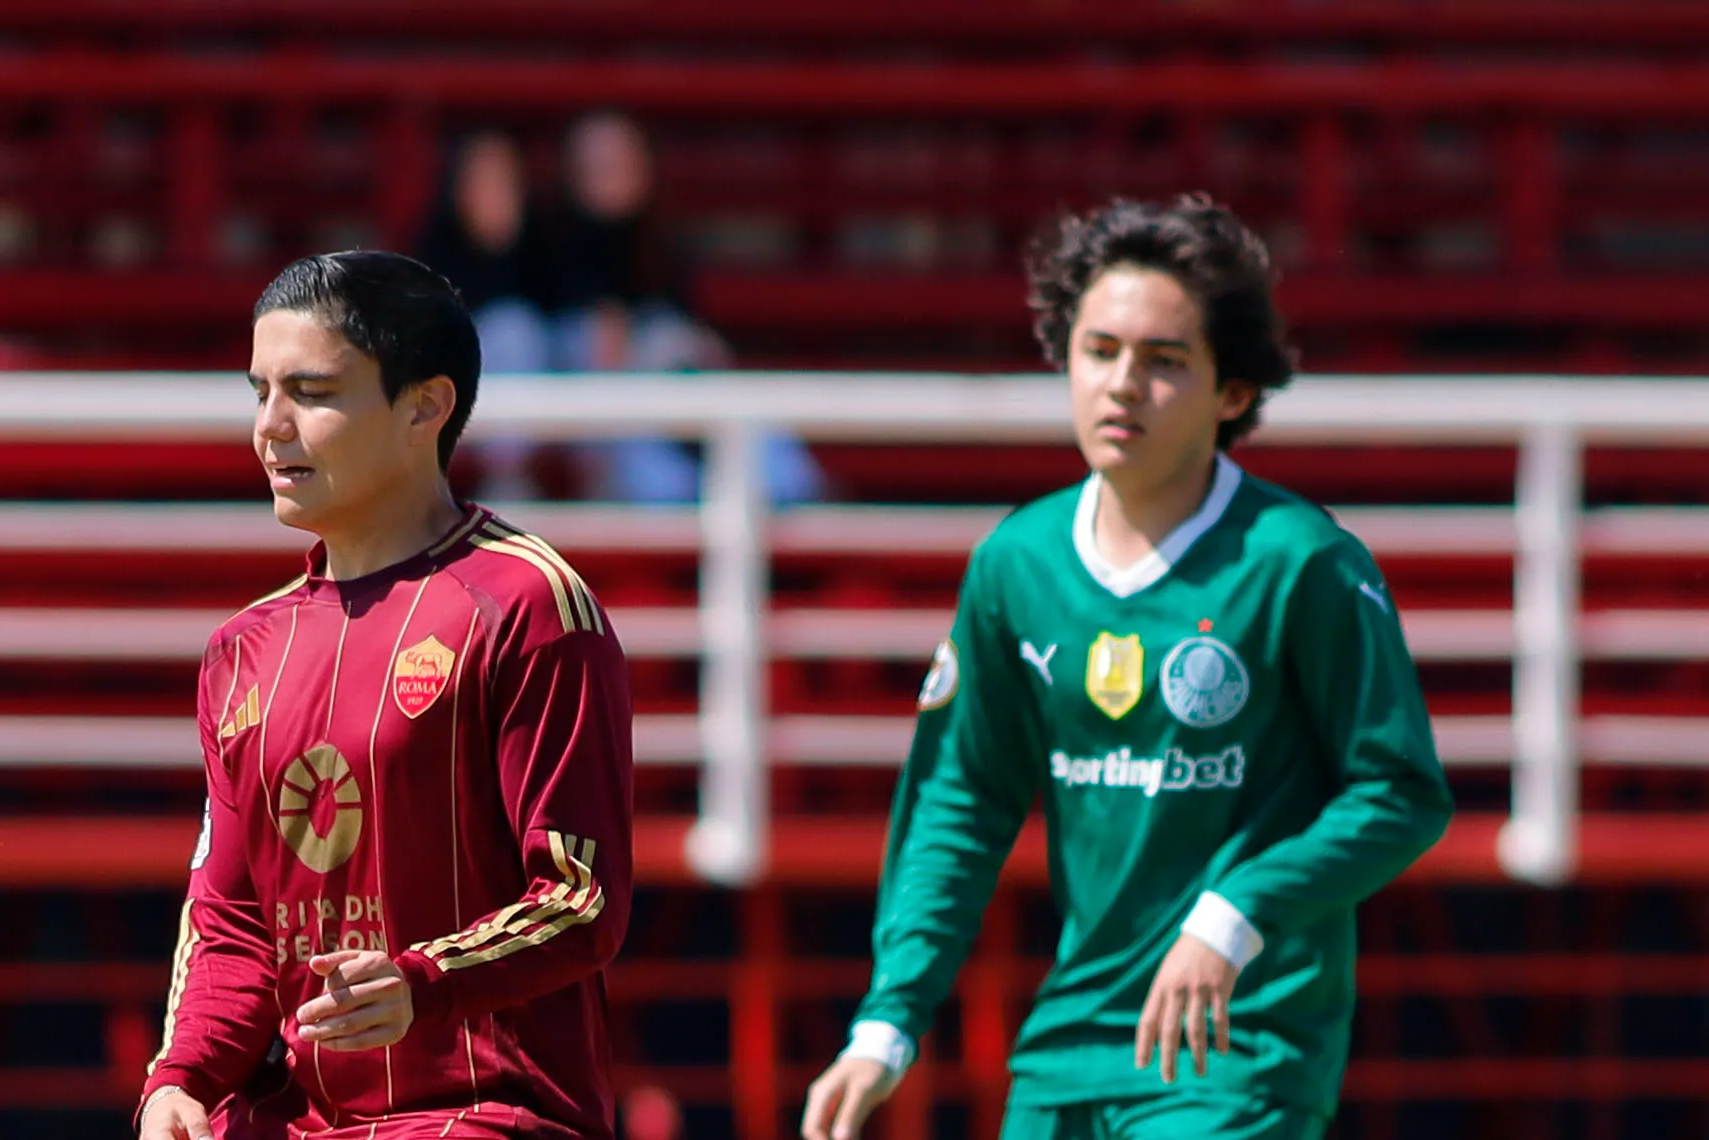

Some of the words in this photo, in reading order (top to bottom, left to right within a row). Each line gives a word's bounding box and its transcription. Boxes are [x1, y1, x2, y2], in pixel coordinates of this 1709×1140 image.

[398, 681, 437, 695] ROMA
[275, 894, 384, 930] RIYADH
[275, 929, 385, 965] SESON
